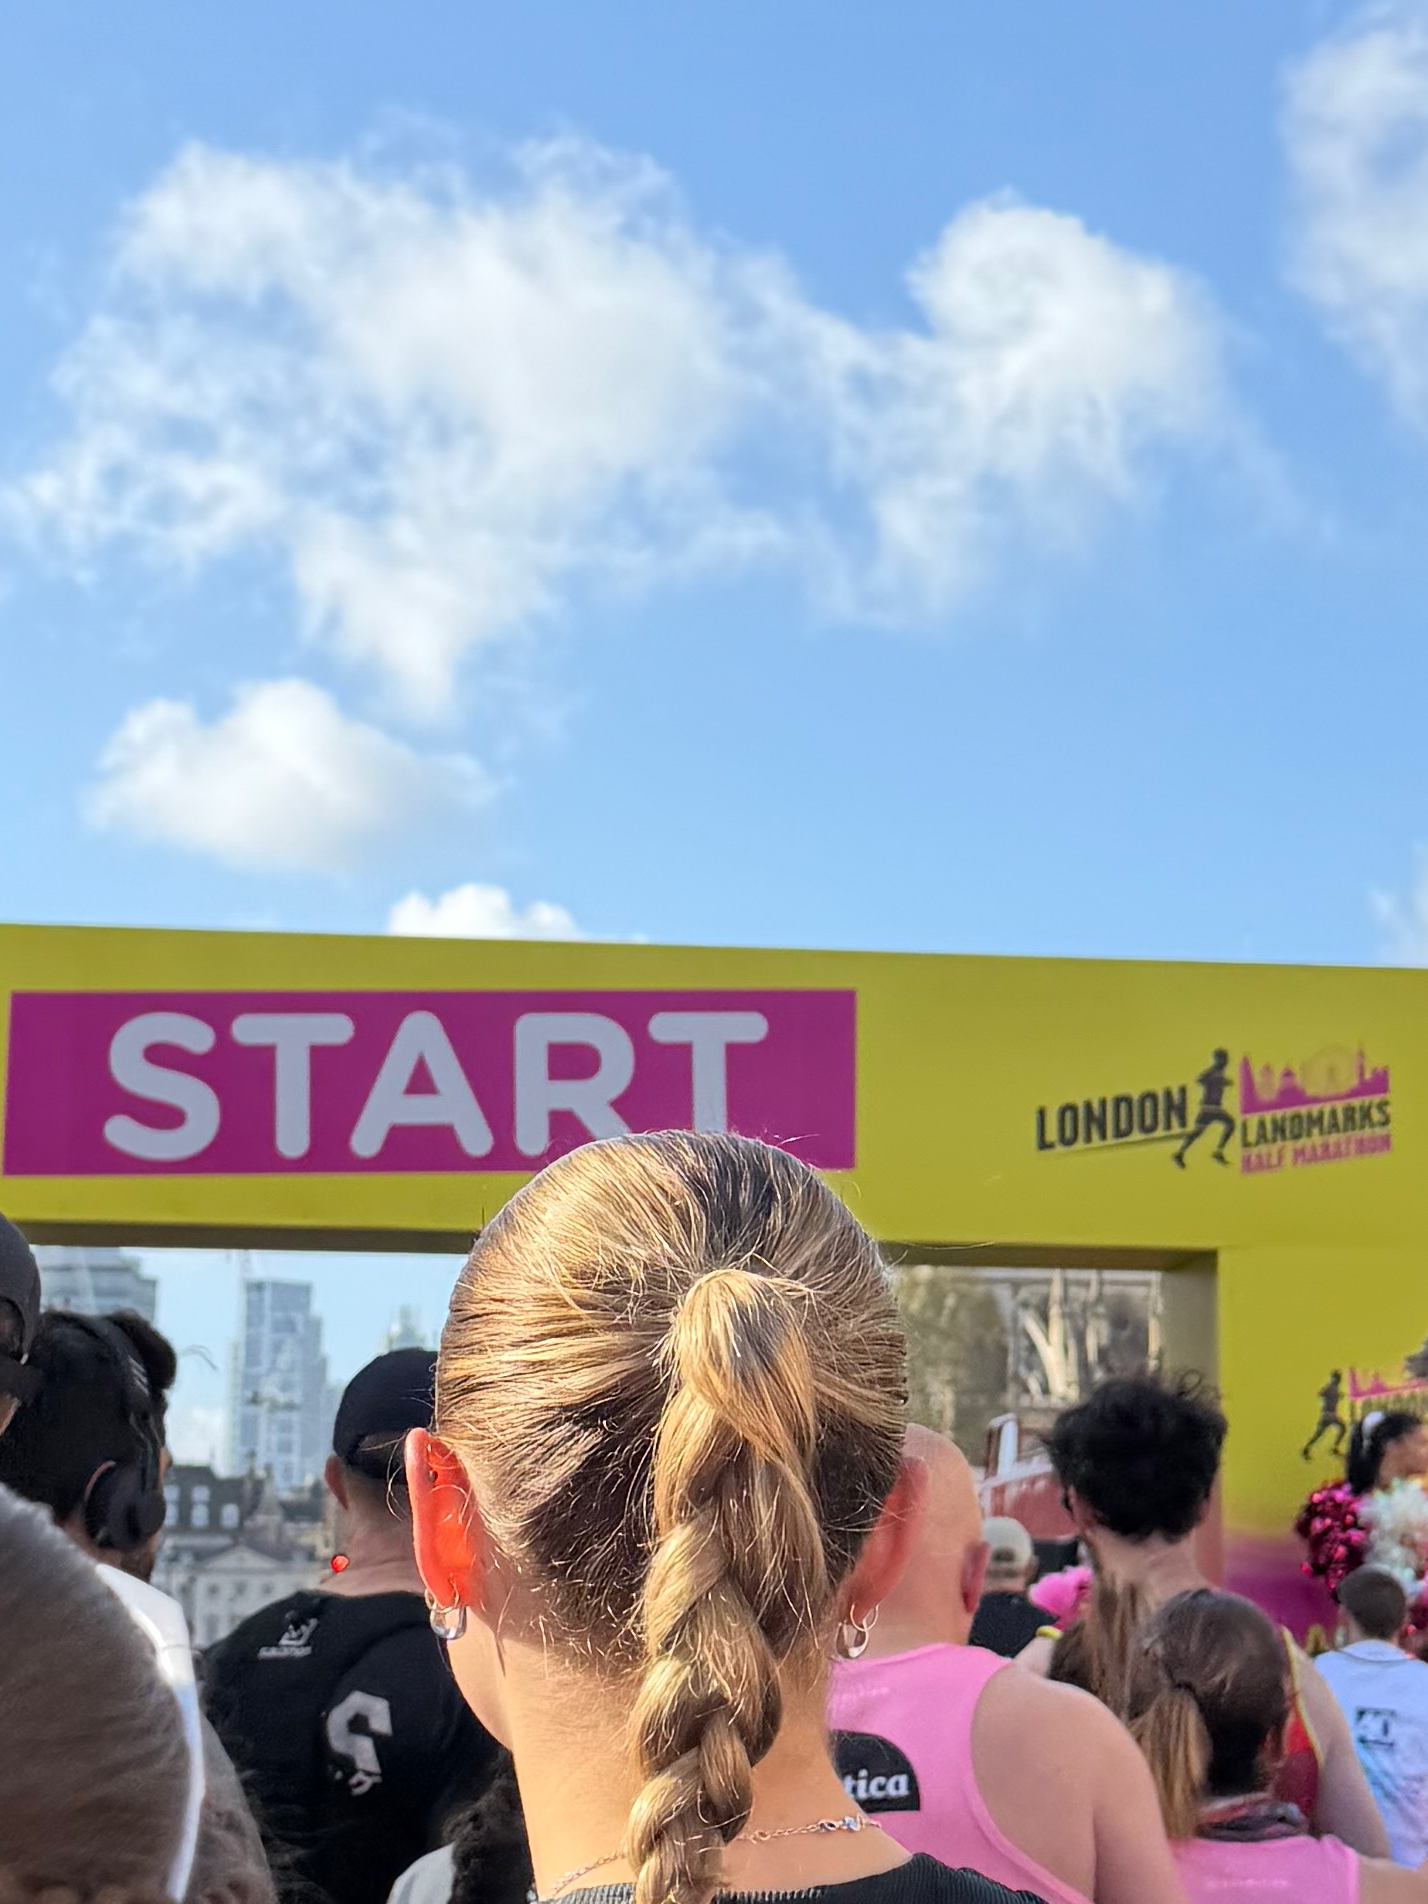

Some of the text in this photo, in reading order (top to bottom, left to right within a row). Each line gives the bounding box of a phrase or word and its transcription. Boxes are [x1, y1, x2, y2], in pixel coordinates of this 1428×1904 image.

[103, 1010, 769, 1162] START
[1036, 1084, 1392, 1152] LONDON LANDMARKS
[842, 1768, 910, 1800] tica
